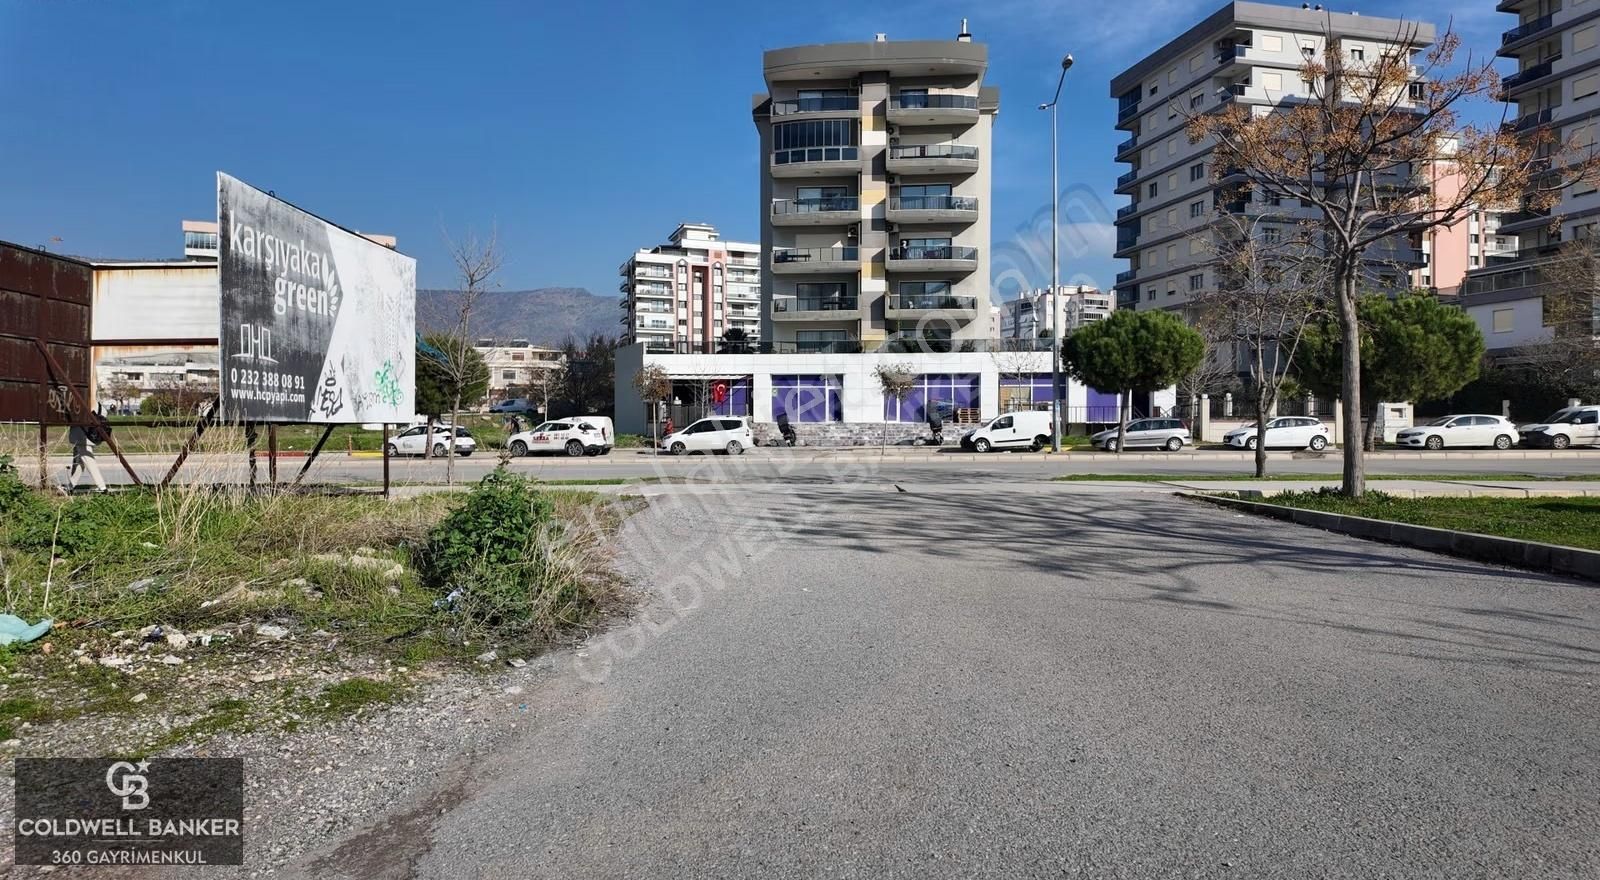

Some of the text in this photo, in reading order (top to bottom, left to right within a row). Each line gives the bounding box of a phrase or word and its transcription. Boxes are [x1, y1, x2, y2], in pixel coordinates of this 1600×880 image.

[229, 210, 321, 279] karşıyaka
[273, 276, 328, 315] green
[231, 367, 305, 390] 0 232 388 08 91
[230, 387, 306, 405] www.hcpyapi.com
